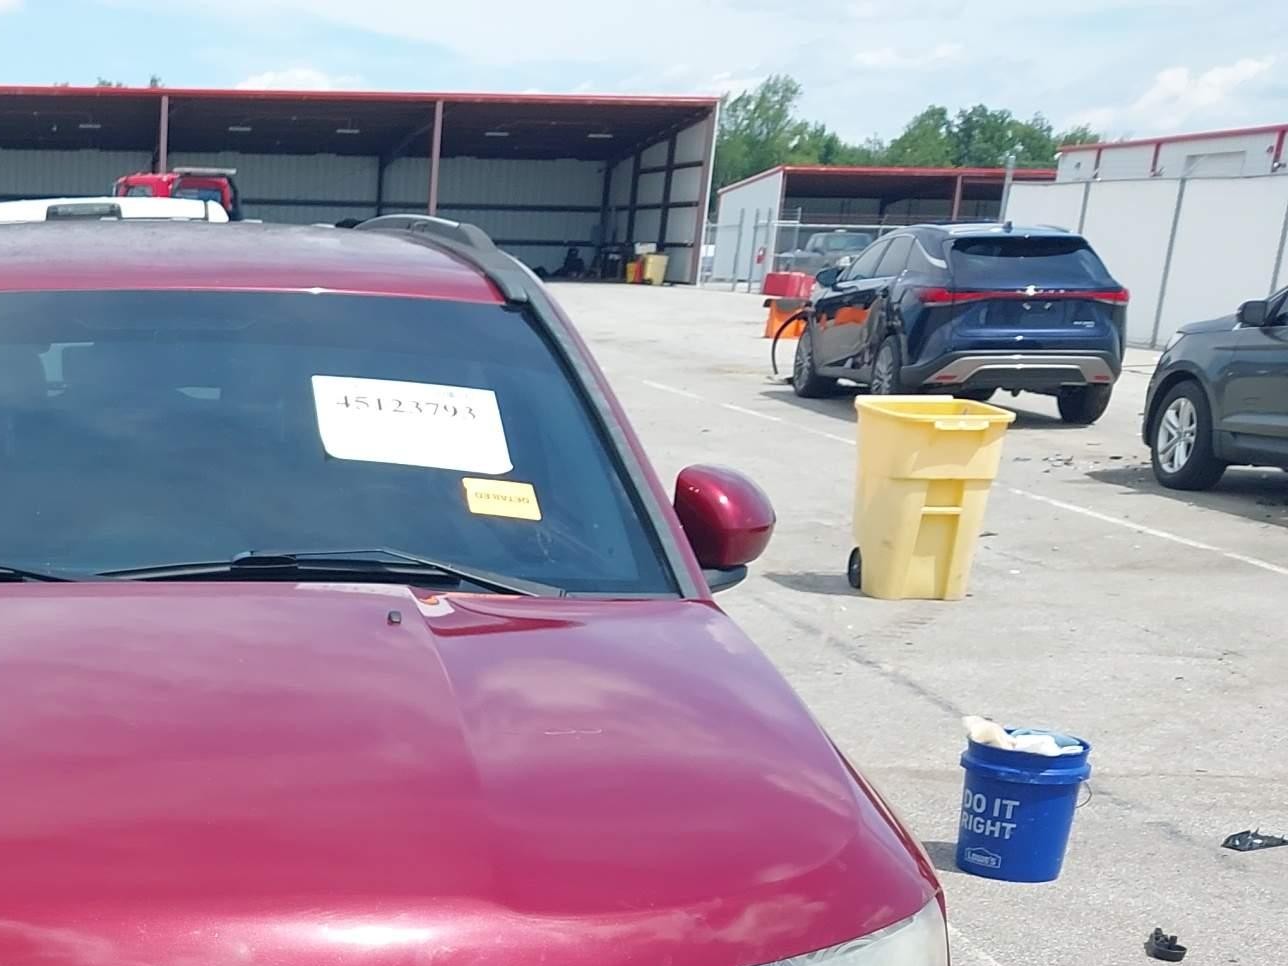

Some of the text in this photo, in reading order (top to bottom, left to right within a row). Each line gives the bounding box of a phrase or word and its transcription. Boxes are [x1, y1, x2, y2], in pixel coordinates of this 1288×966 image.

[964, 788, 1020, 820] DO IT
[962, 811, 1017, 840] RIGHT
